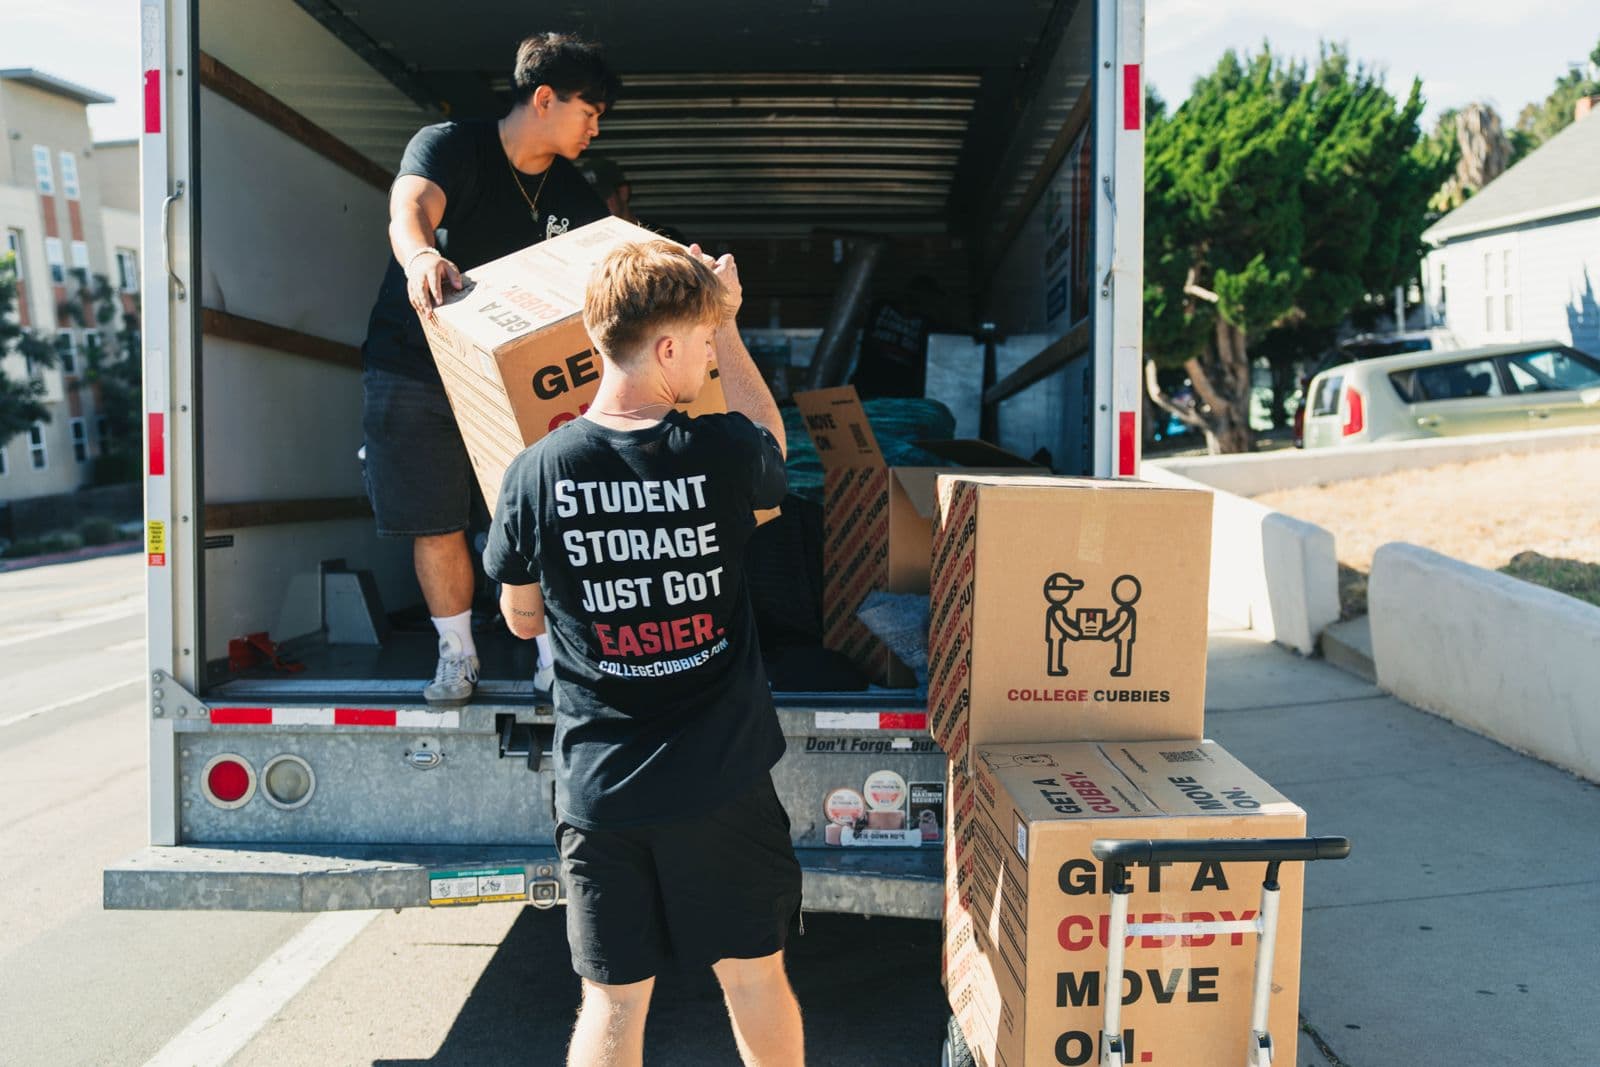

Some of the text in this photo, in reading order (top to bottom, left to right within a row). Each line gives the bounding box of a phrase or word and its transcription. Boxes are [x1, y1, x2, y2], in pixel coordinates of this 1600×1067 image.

[488, 310, 532, 333] GET
[532, 346, 600, 400] GE
[555, 474, 707, 518] STUDENT
[562, 522, 720, 567] STORAGE
[582, 566, 723, 613] JUST GOT
[594, 613, 726, 657] EASIER.
[1007, 689, 1170, 702] COLLEGE CUBBIES
[806, 737, 936, 754] Don't Forge our
[1032, 778, 1083, 815] GET A
[1060, 771, 1121, 814] CUBBY.
[1167, 776, 1228, 810] MOVE
[1220, 787, 1262, 810] ON.
[1190, 860, 1230, 892] A
[1056, 967, 1219, 1007] MOVE
